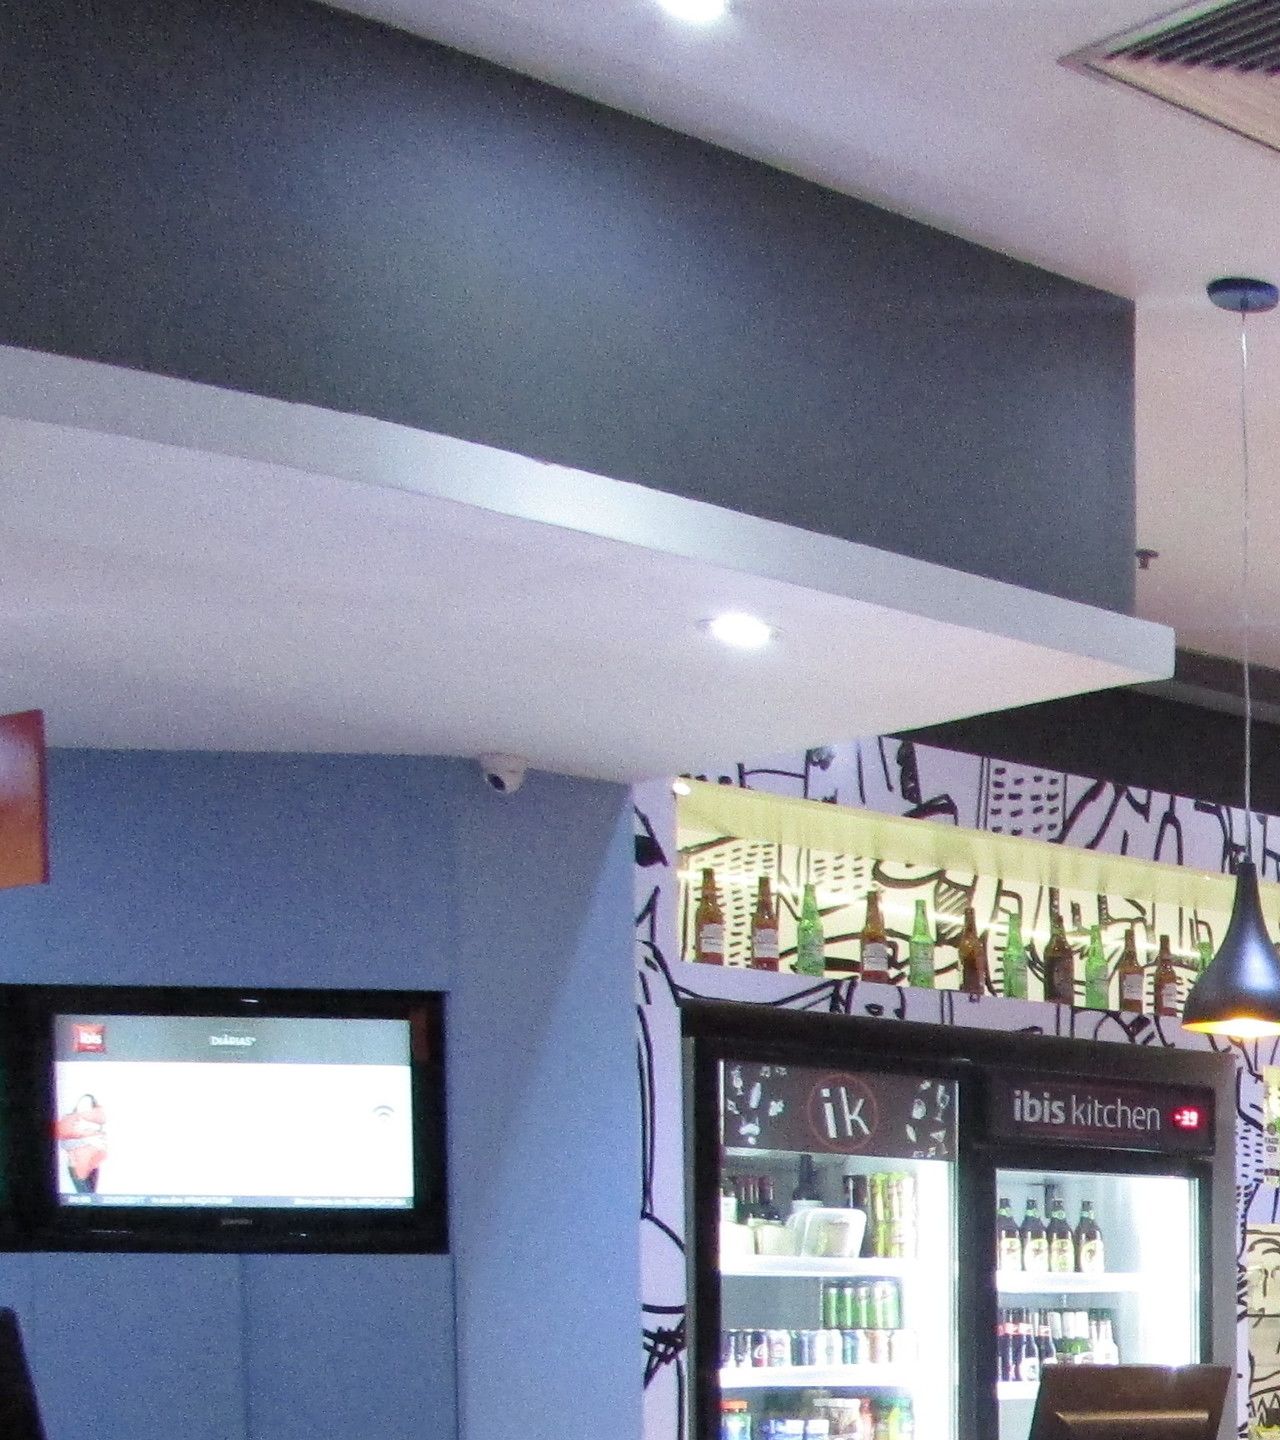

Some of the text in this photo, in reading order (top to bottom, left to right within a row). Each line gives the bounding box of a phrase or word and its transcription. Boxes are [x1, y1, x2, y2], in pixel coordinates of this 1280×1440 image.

[821, 1085, 871, 1139] ik
[1013, 1089, 1161, 1131] ibis kitchen
